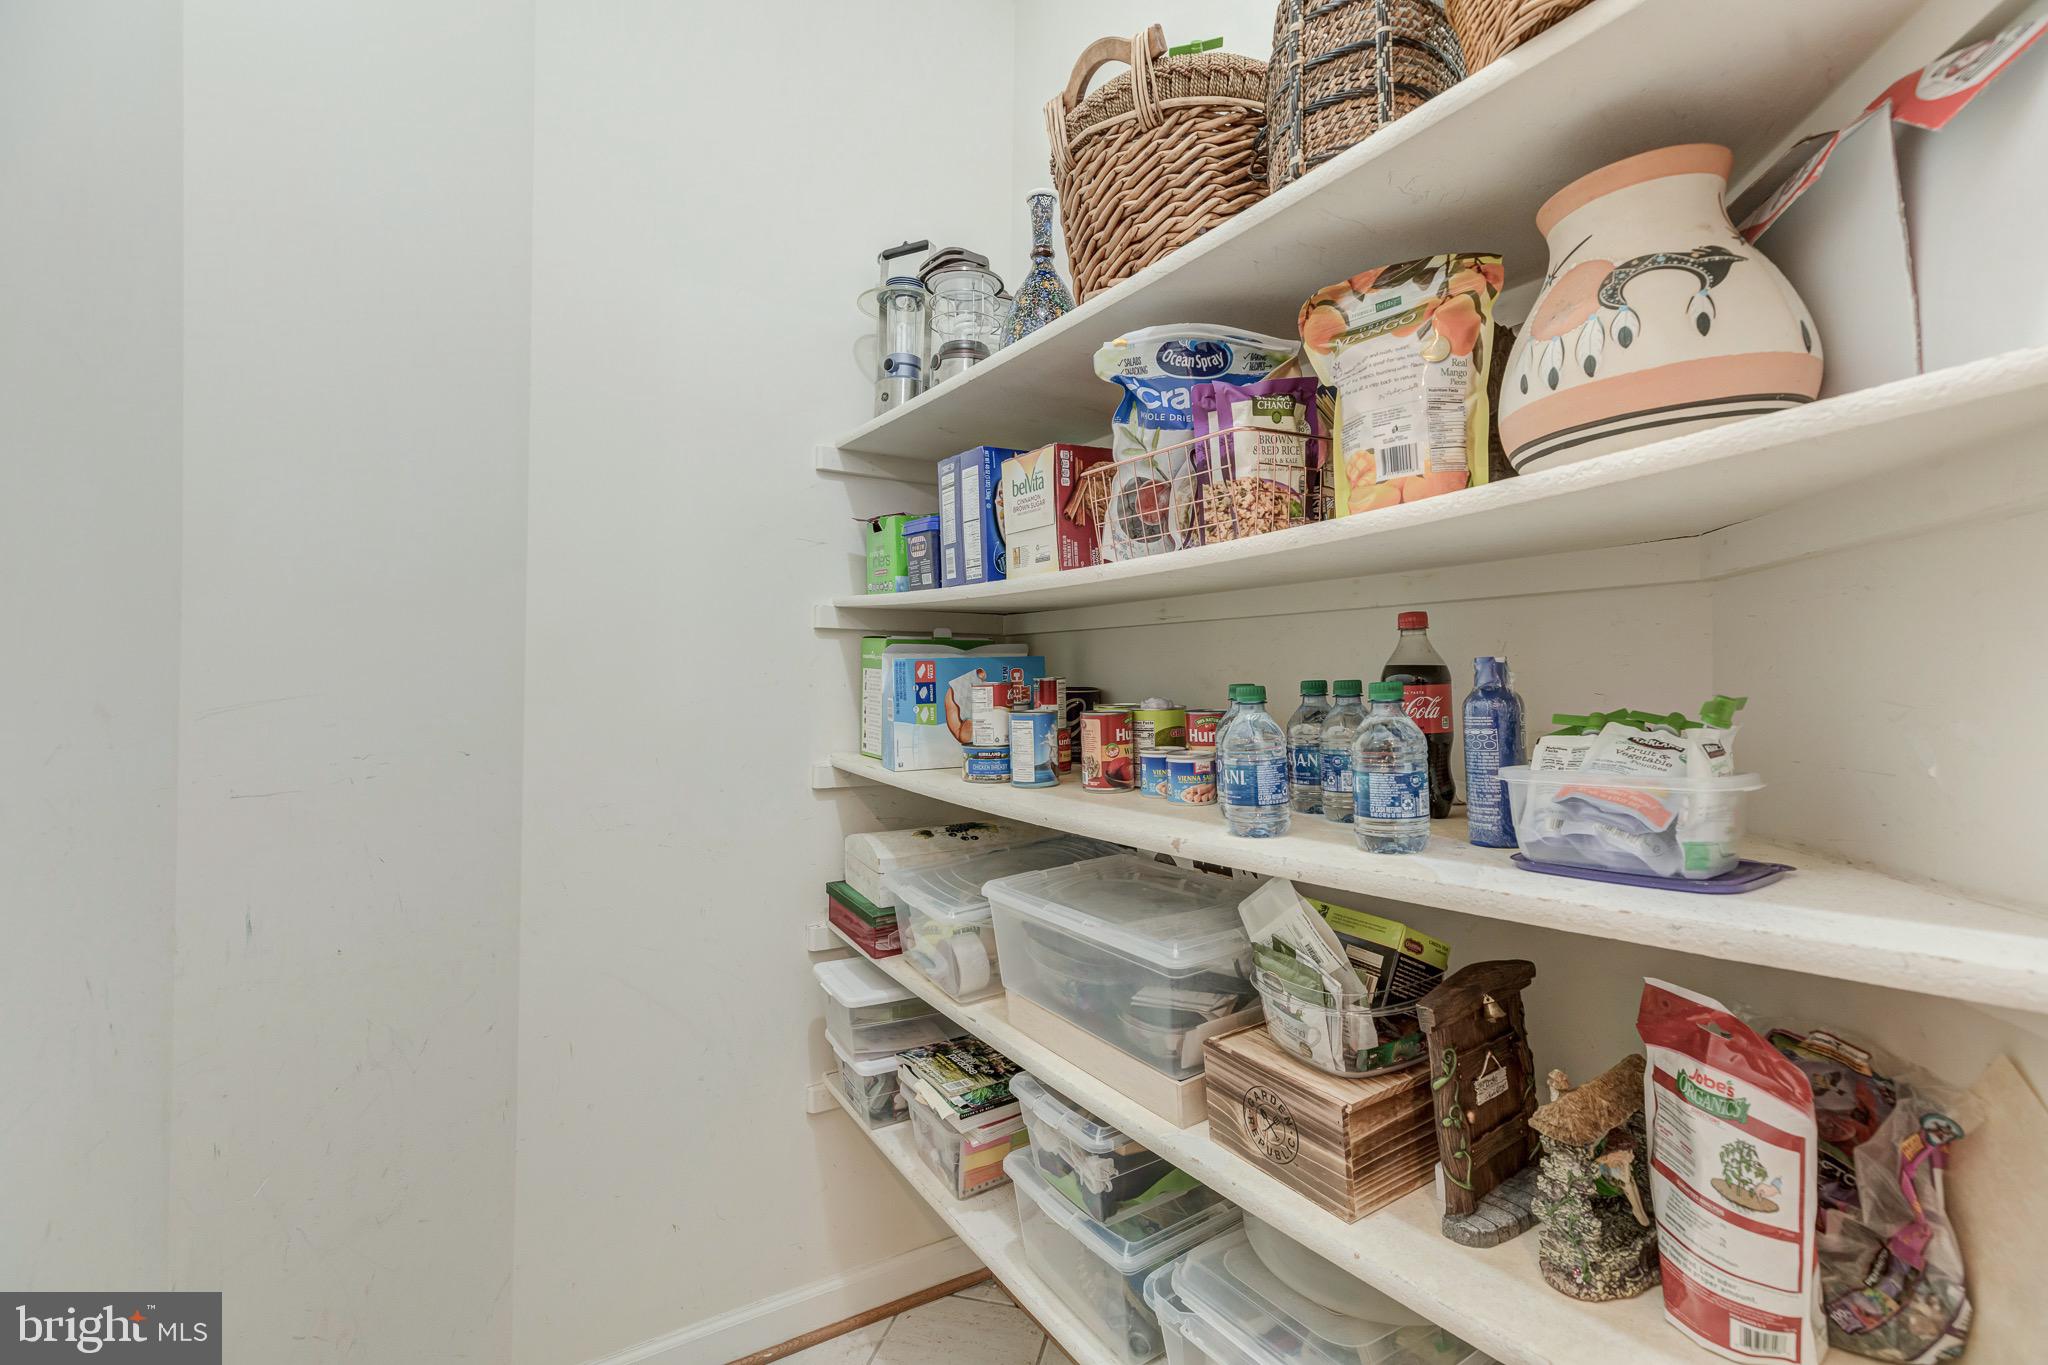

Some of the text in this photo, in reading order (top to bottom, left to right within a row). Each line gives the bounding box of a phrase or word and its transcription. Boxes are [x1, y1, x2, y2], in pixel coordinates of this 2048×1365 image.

[1161, 349, 1225, 372] Ocean Spray
[1451, 358, 1468, 367] Real
[1440, 368, 1468, 380] Mango
[1136, 387, 1194, 410] Cra
[1169, 413, 1194, 423] DRIE
[1259, 434, 1294, 445] BROWN
[1261, 446, 1280, 456] RED
[1281, 446, 1302, 456] RICE
[1012, 472, 1045, 498] belVita
[1013, 500, 1046, 513] BROWN SUGAR
[1016, 496, 1040, 506] CINNAMON
[1624, 745, 1658, 757] Fruit
[1615, 748, 1673, 769] Vegetable
[1630, 760, 1669, 773] Pouches
[1689, 1068, 1735, 1098] Jobe's
[1679, 1074, 1746, 1118] ORGANICS
[1247, 1089, 1294, 1127] GARDEN
[1248, 1116, 1295, 1160] REPUBLIC
